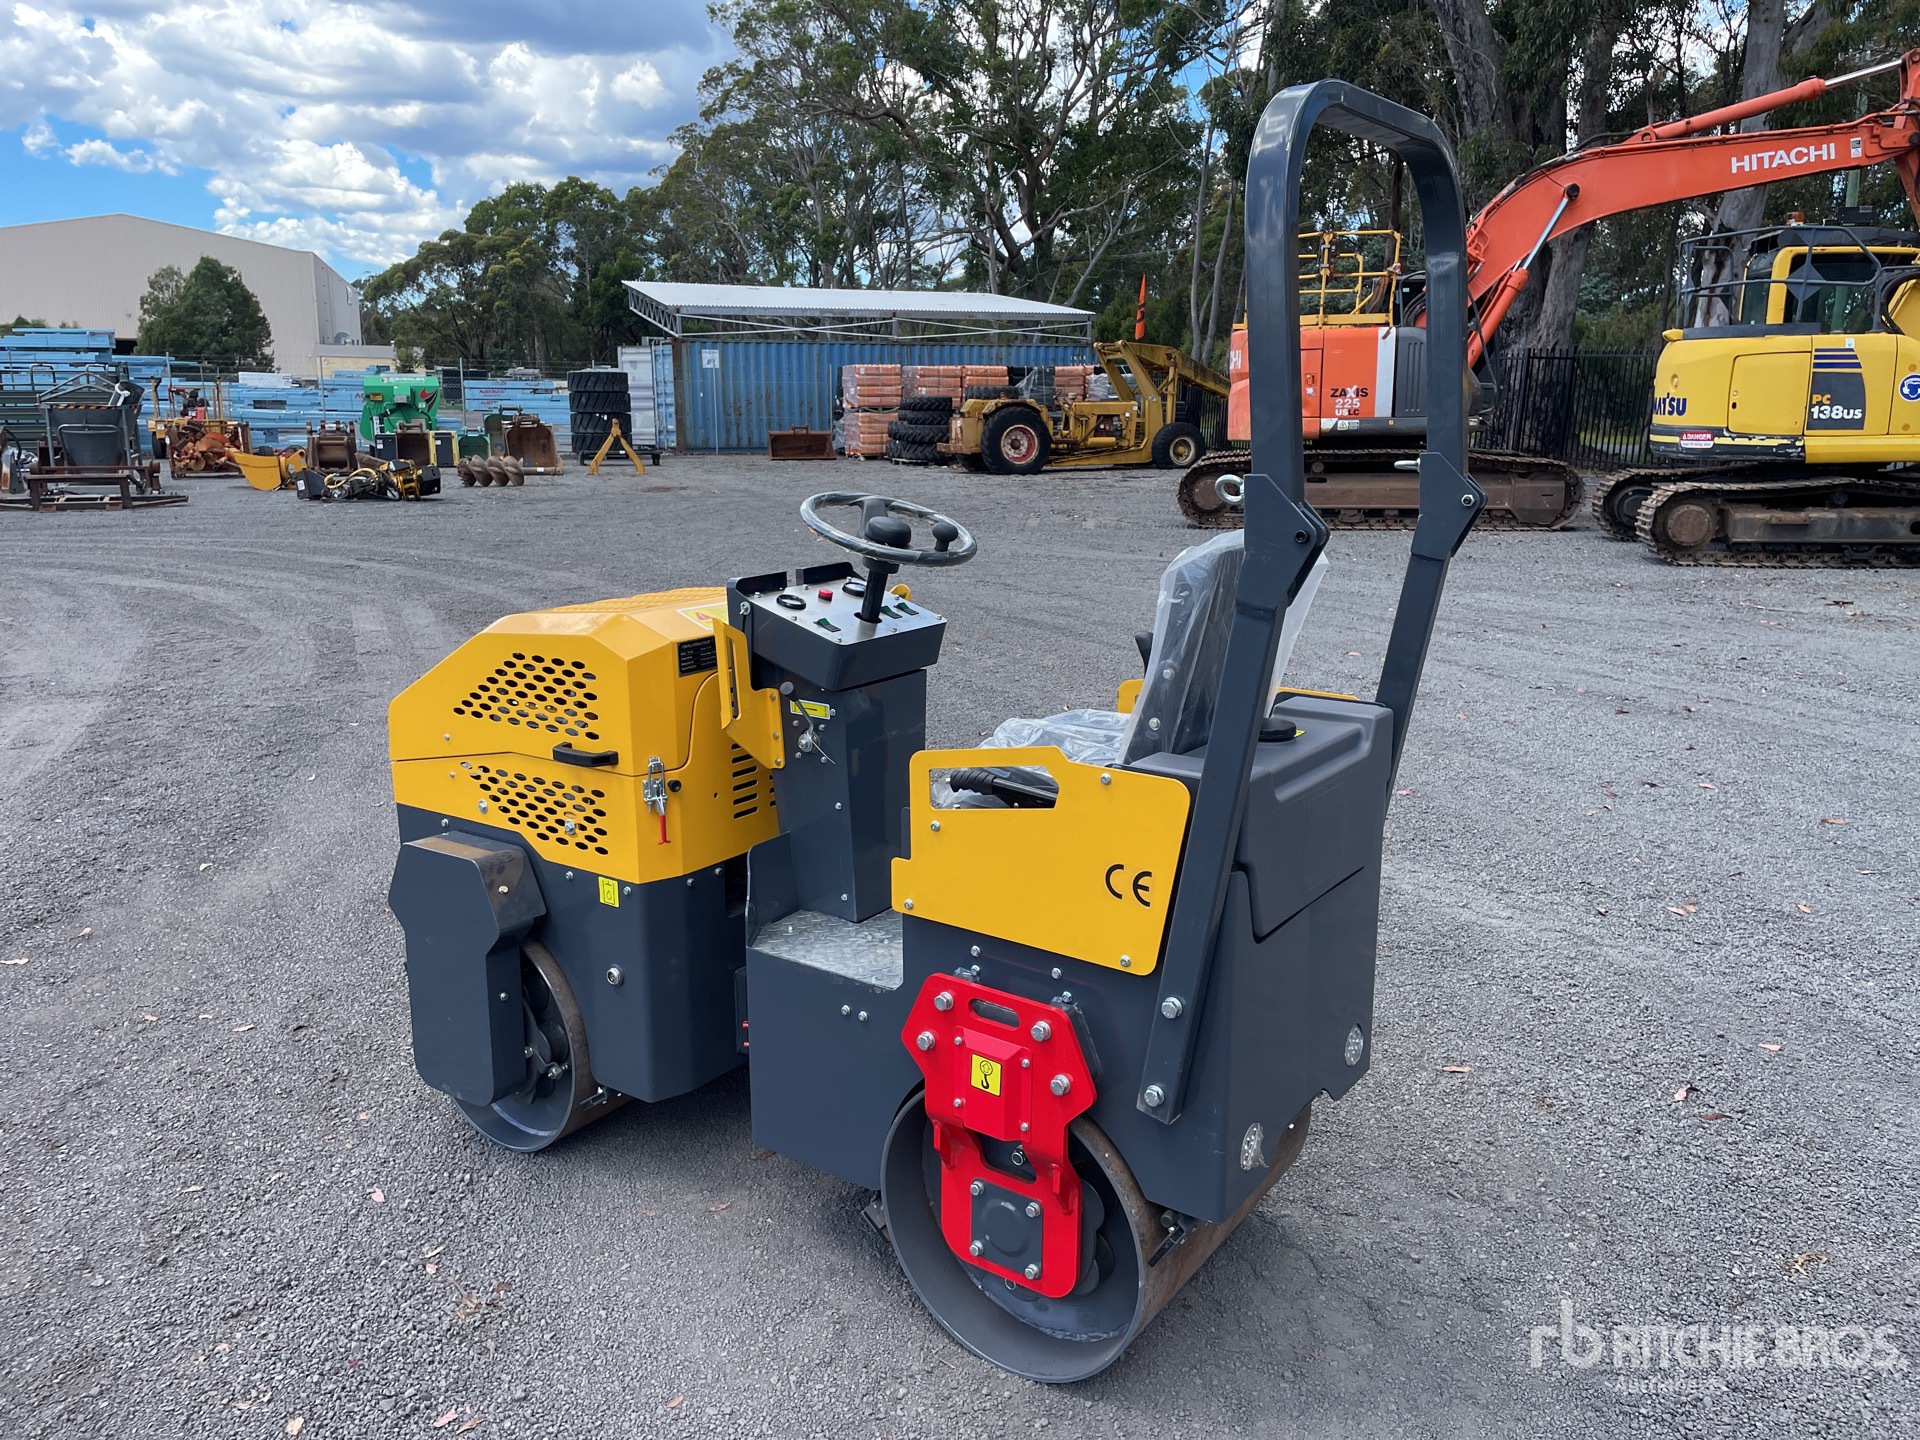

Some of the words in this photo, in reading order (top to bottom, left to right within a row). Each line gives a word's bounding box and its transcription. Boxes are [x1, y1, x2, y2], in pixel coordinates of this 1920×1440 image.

[1731, 143, 1836, 174] HITACHI
[1330, 385, 1368, 398] ZAXIS
[1335, 398, 1360, 408] 225
[1811, 394, 1831, 405] PC
[1335, 408, 1360, 416] USLC
[1687, 433, 1712, 441] DANGER
[1105, 863, 1153, 908] CE
